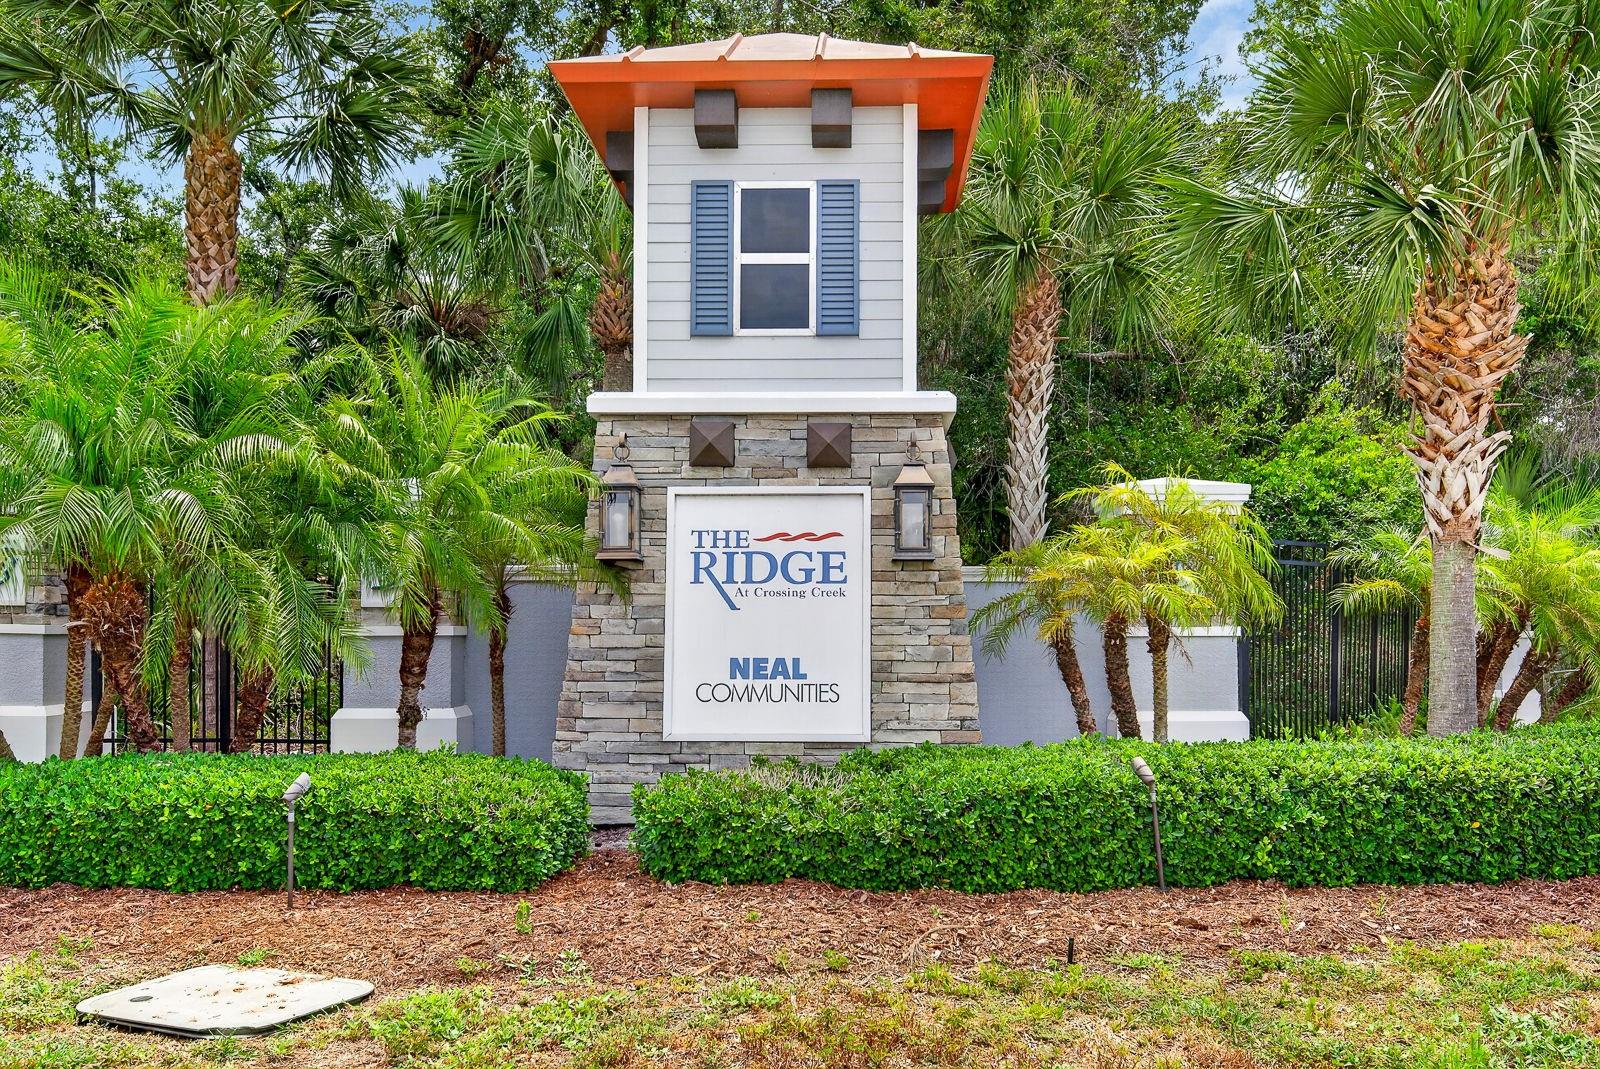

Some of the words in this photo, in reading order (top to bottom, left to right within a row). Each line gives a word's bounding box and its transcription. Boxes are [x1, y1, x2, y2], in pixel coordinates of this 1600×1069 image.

[691, 530, 750, 549] THE
[689, 550, 848, 610] RIDGE
[735, 587, 749, 598] At
[754, 587, 806, 599] Crossing
[811, 587, 846, 598] Creek
[729, 657, 807, 680] NEAL
[695, 683, 840, 703] COMMUNITIES
